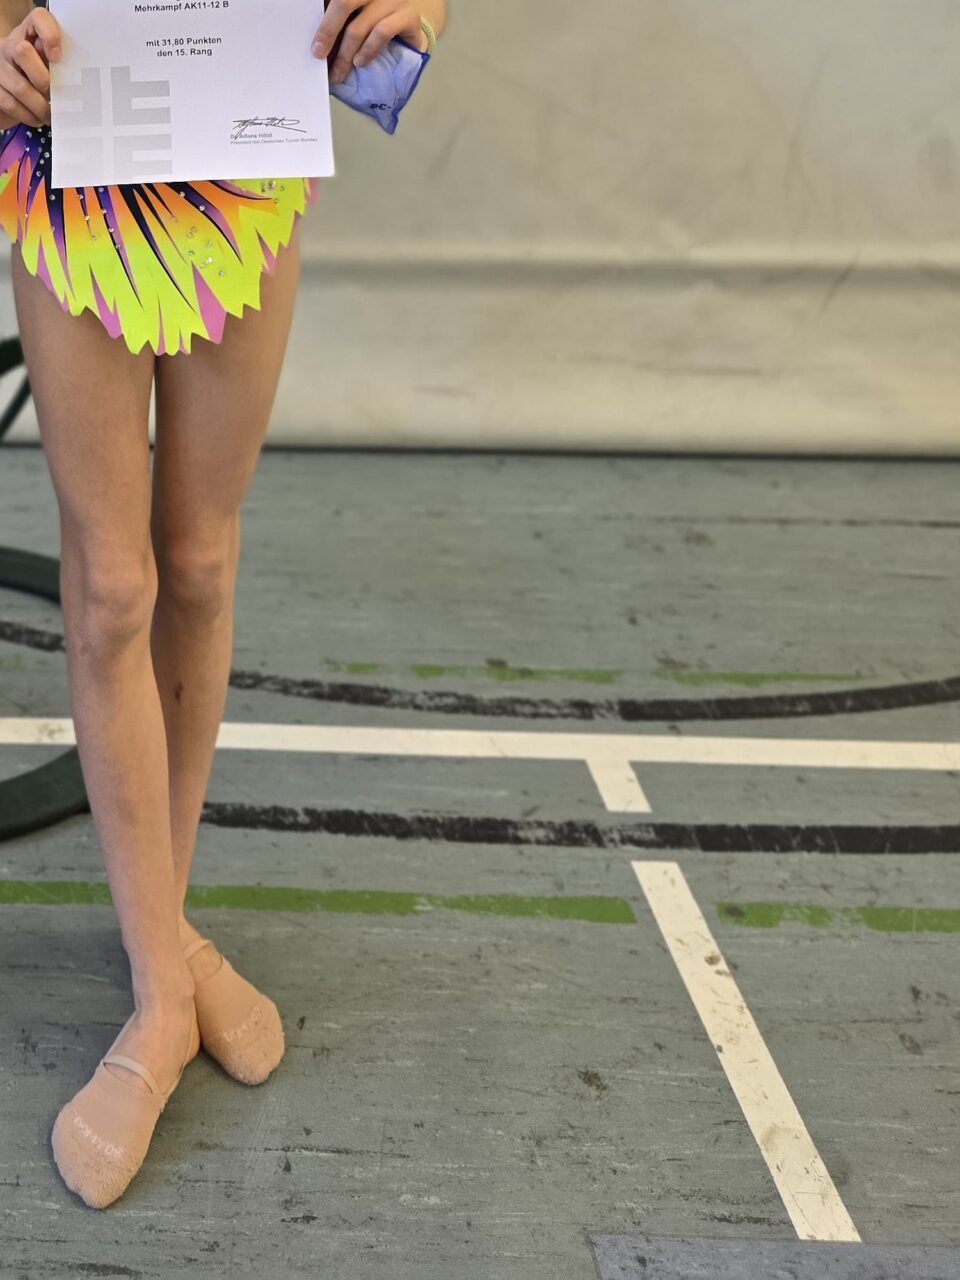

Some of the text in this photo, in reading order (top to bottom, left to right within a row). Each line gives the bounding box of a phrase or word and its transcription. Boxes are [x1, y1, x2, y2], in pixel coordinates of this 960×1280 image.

[134, 3, 182, 12] Mehrkampf
[184, 1, 220, 10] AK11-12
[162, 38, 184, 46] 31,80
[187, 37, 222, 45] Punkten
[190, 48, 212, 56] Rang
